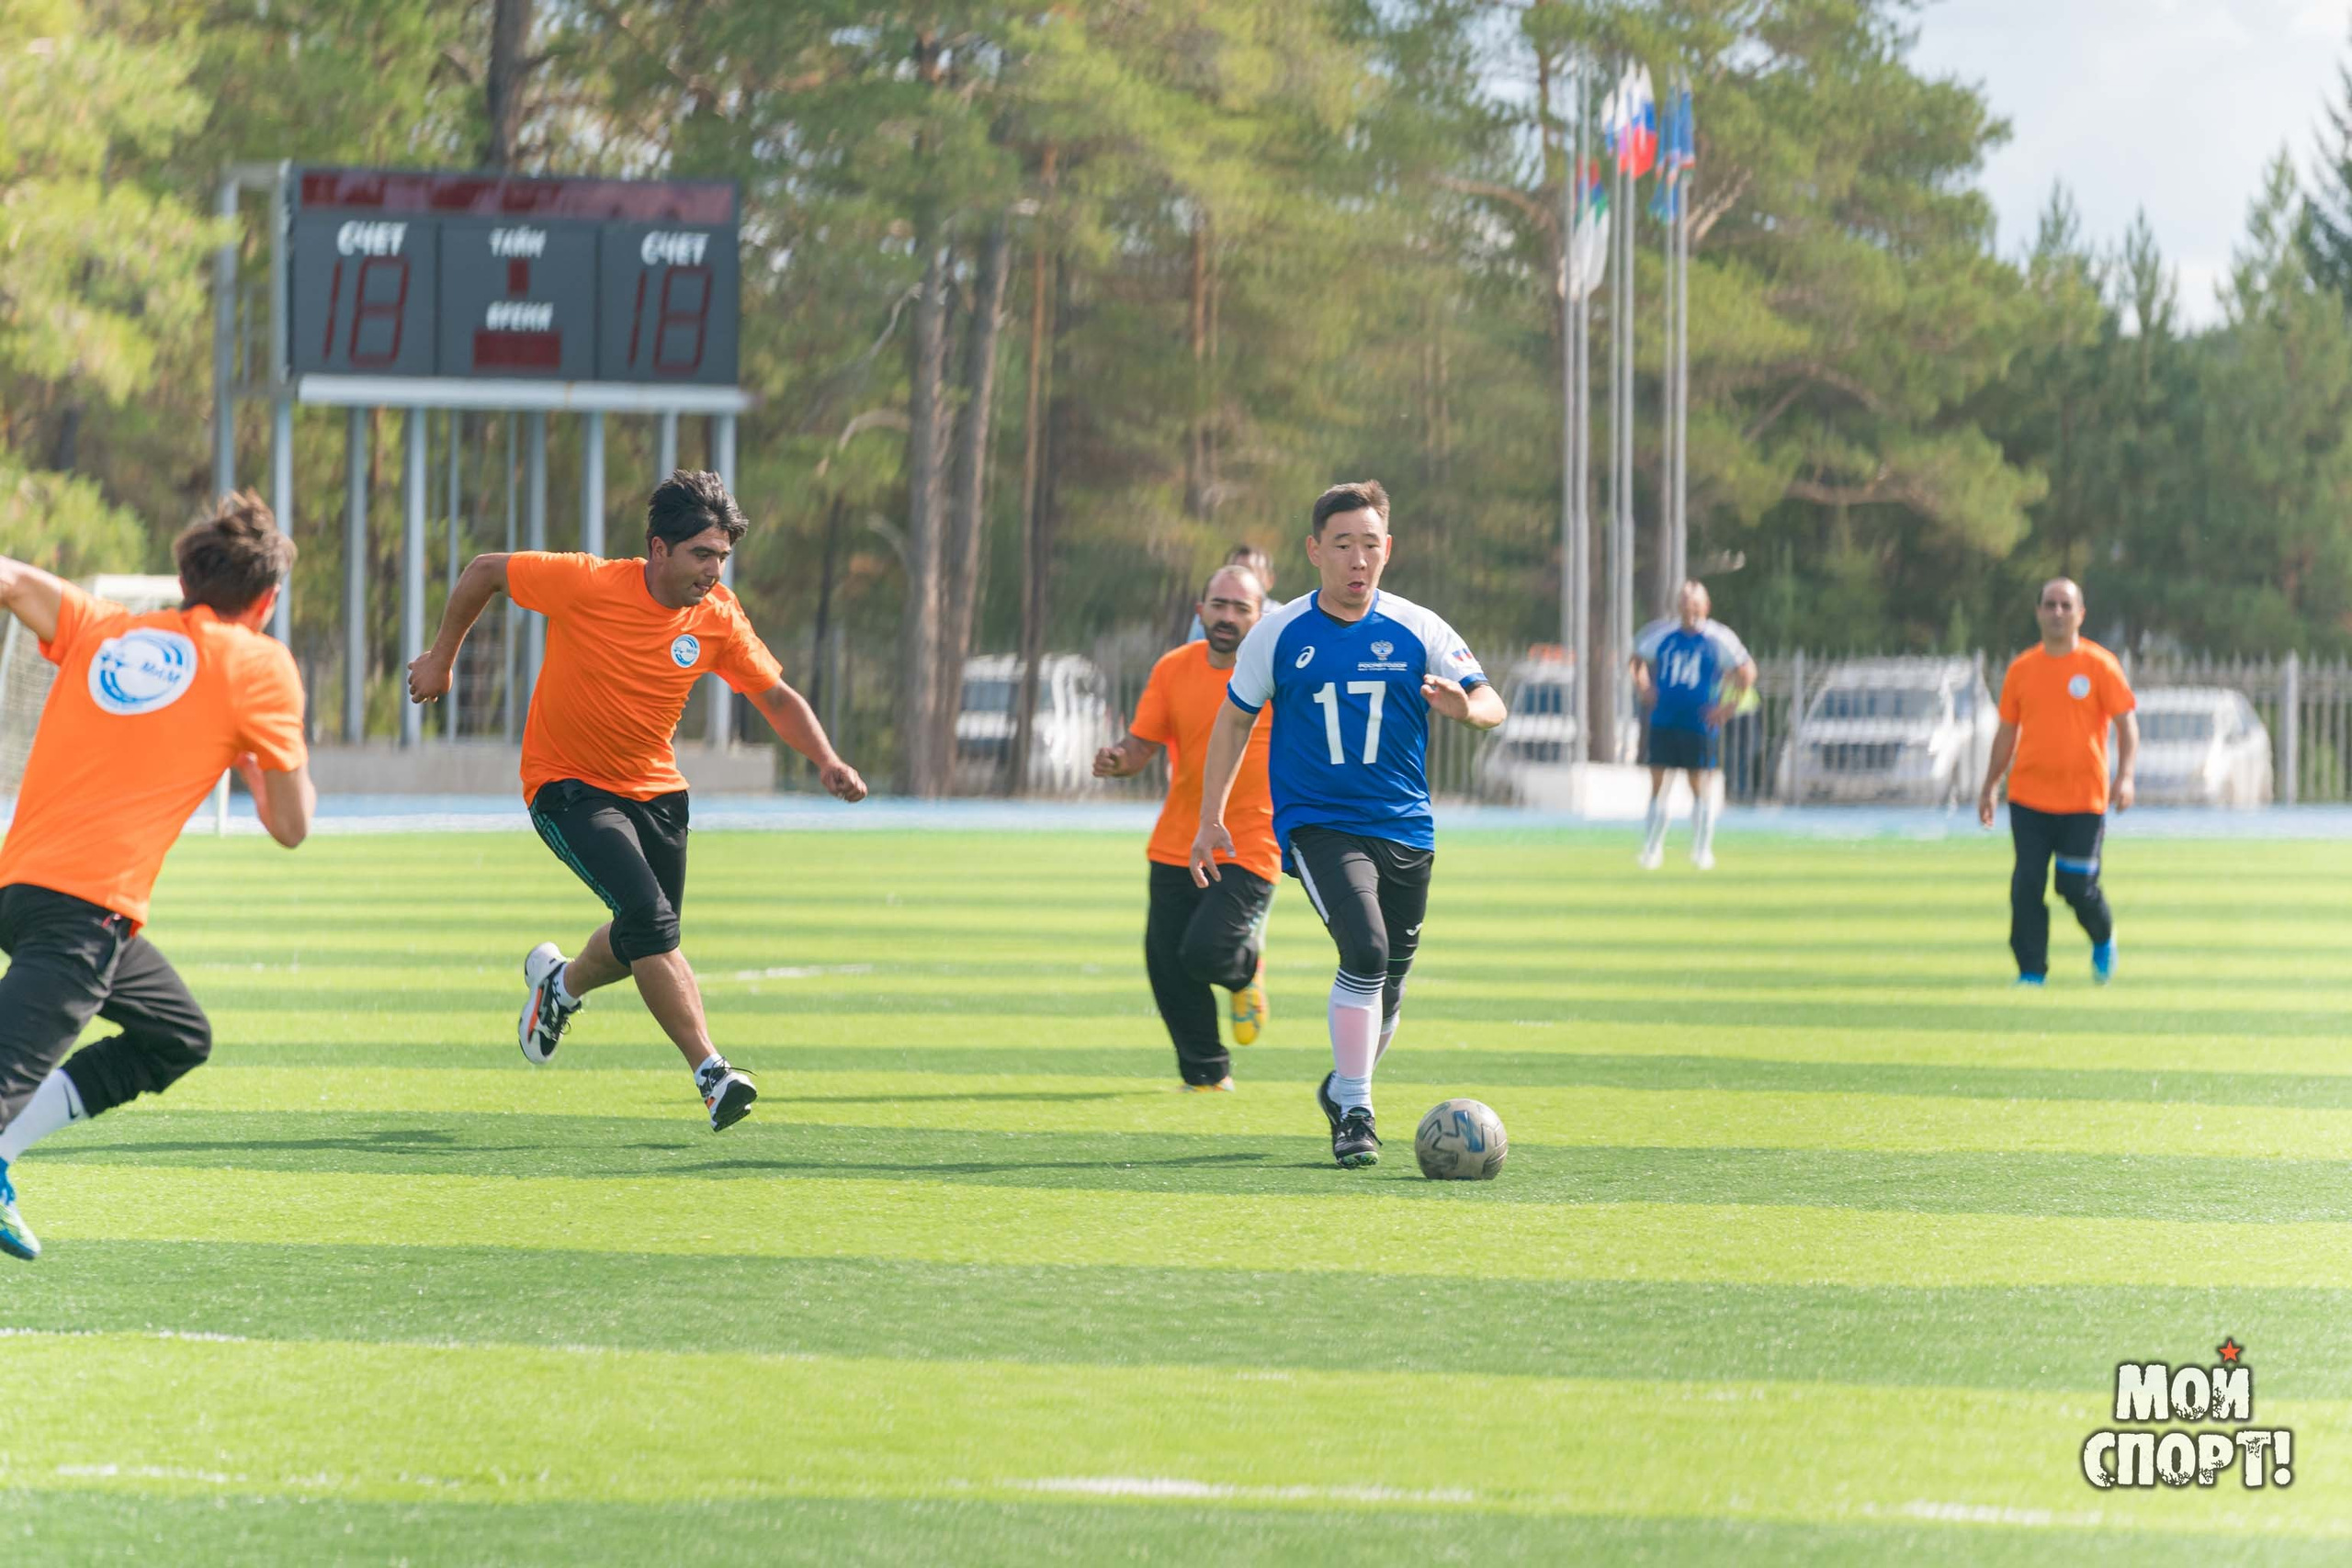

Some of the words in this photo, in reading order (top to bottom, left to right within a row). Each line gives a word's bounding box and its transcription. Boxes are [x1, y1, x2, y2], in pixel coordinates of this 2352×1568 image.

[336, 220, 409, 256] СЧЕТ
[641, 231, 710, 266] СЧЕТ
[1313, 681, 1385, 764] 17
